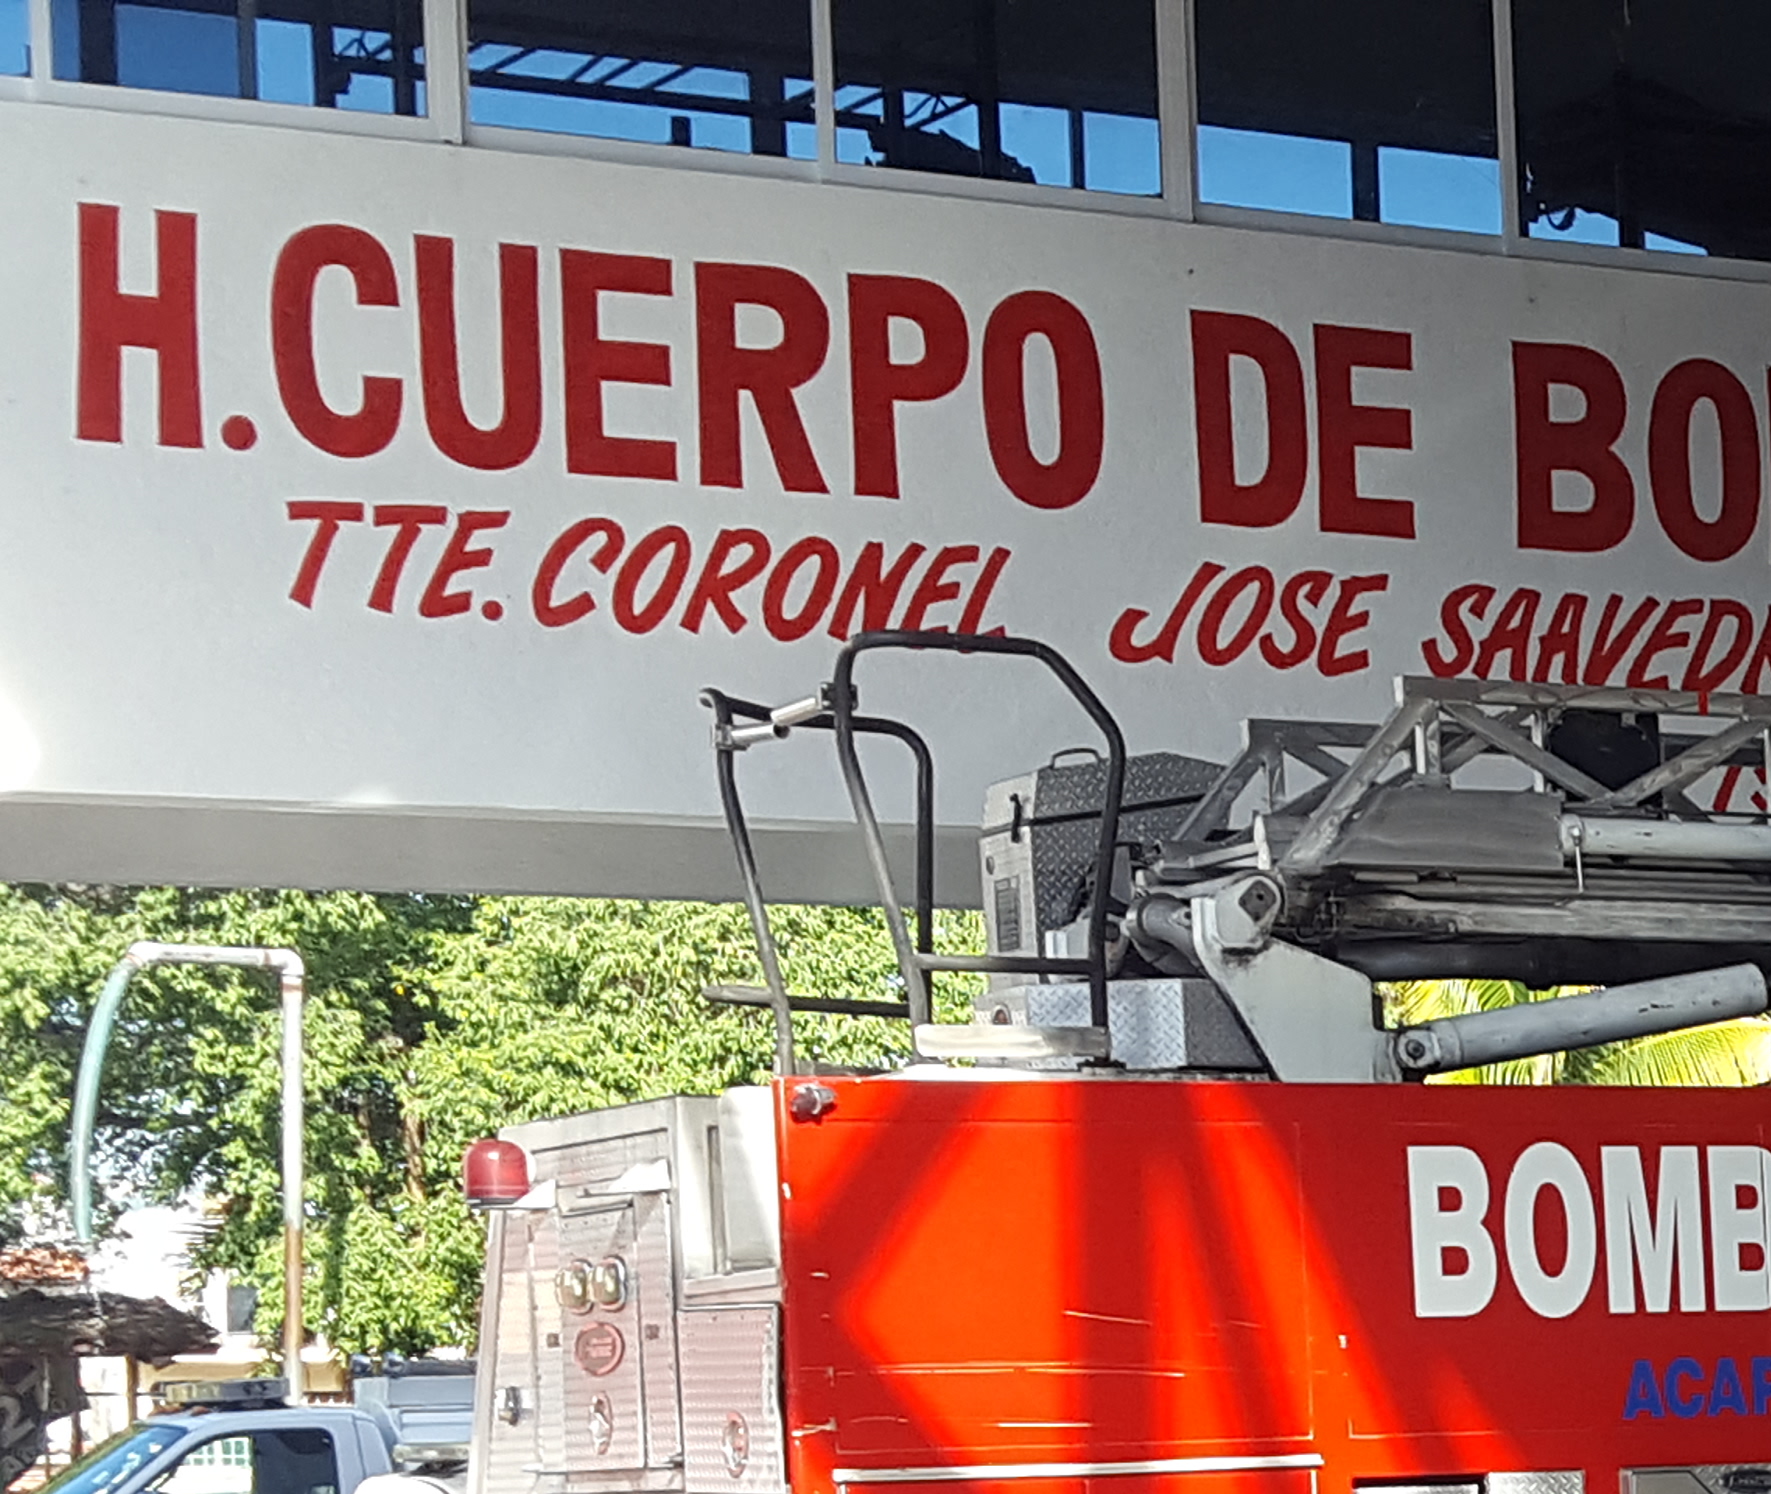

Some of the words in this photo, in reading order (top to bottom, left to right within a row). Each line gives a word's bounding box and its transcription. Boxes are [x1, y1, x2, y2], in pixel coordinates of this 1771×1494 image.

[1191, 310, 1416, 540] DE
[286, 500, 511, 620] TTE.
[531, 516, 1012, 655] CORONEL
[1109, 562, 1388, 678] JOSE
